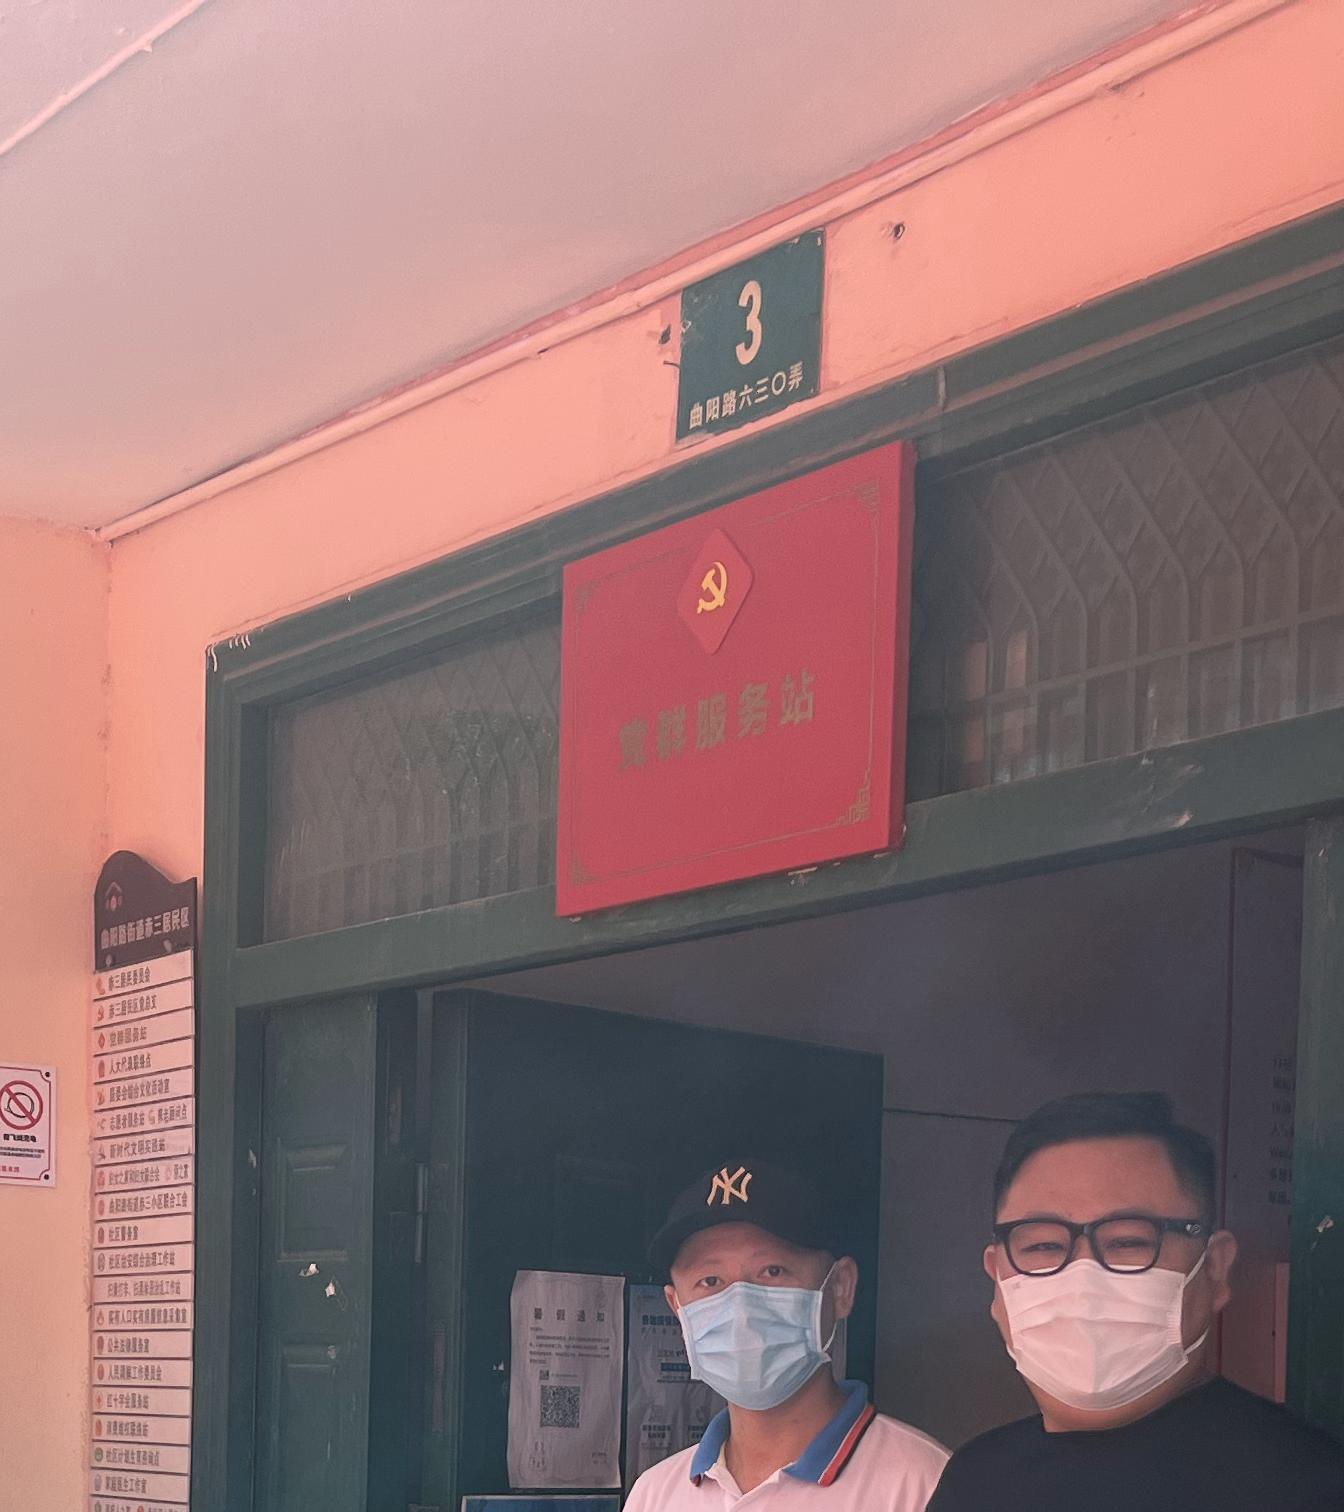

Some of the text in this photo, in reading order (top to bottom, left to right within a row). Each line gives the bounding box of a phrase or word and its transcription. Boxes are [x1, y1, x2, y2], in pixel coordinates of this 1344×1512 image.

[736, 281, 763, 365] 3
[618, 669, 817, 771] 党群服务站
[707, 1166, 753, 1206] NY
